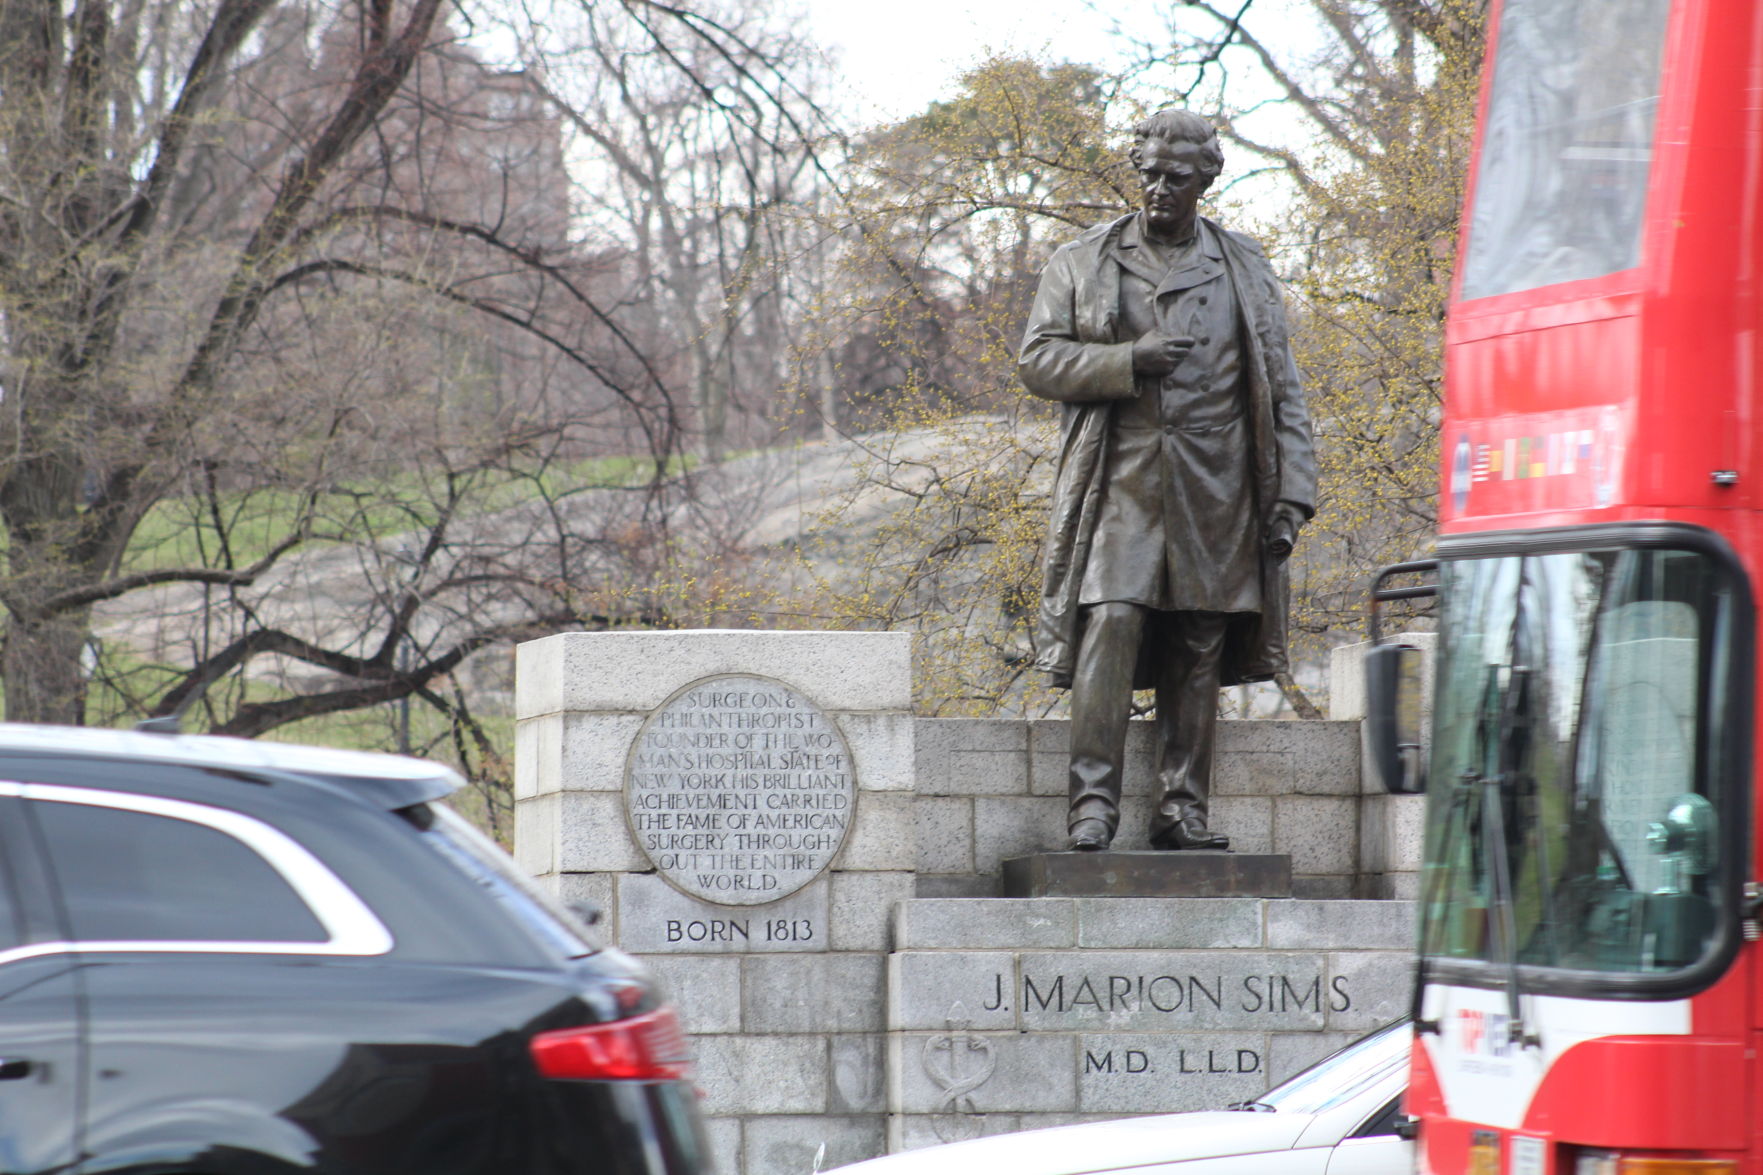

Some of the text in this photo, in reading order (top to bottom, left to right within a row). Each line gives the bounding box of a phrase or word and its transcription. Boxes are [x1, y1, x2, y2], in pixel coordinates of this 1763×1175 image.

[687, 692, 783, 709] SURGEON
[661, 712, 818, 729] PHILANTHROPIST
[647, 732, 729, 749] FOUNDER
[734, 732, 757, 750] OF
[761, 732, 801, 749] THE
[697, 751, 776, 770] HOSPITAL
[779, 750, 824, 771] STATE
[632, 773, 849, 790] NEW YORK HIS BRILLIANT
[633, 793, 848, 810] ACHIEVEMENT CARRIED
[634, 813, 846, 830] THE FAME OF AMERICAN
[647, 833, 729, 850] SURGERY
[659, 854, 819, 871] OUT THE ENTIRE
[696, 874, 782, 891] WORLD.
[666, 919, 814, 943] BORN 1813
[983, 974, 1009, 1012] J.
[1024, 974, 1222, 1013] MARION
[1085, 1049, 1263, 1074] M.D. L.L.D.
